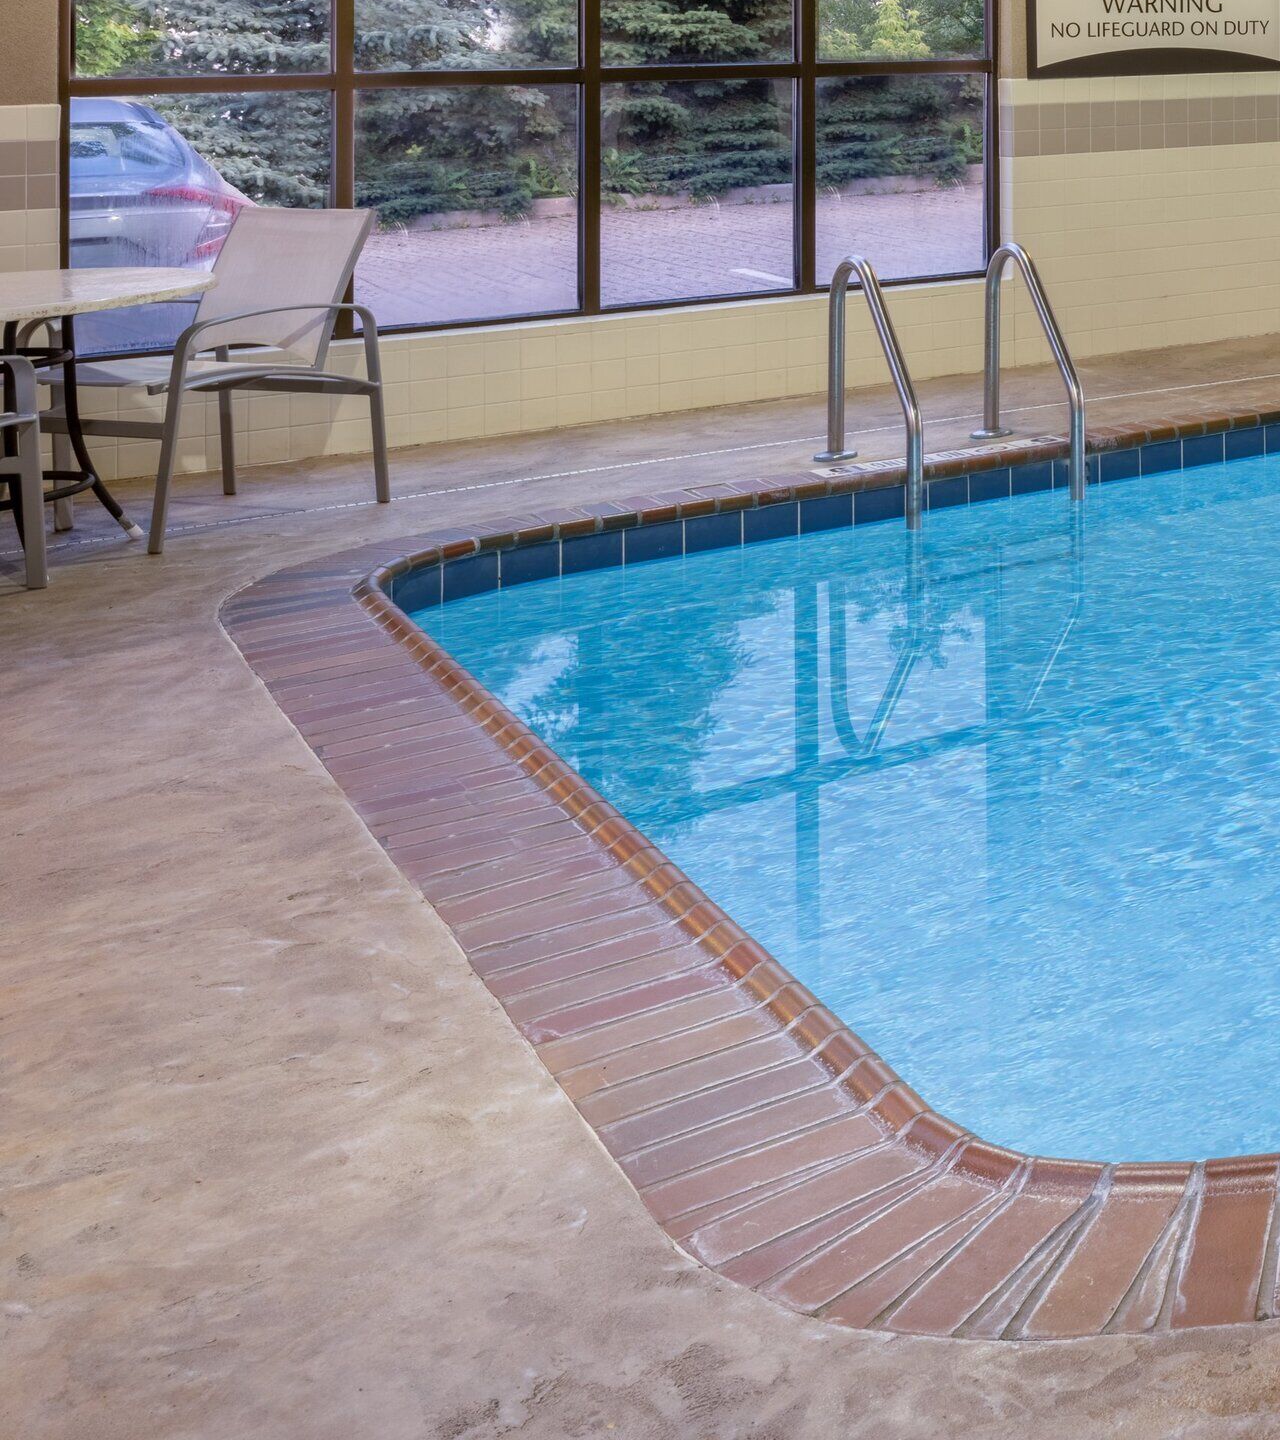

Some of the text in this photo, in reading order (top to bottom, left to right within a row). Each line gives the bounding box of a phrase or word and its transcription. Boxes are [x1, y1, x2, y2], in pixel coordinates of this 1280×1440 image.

[1050, 20, 1269, 38] NO LIFEGUARD ON DUTY
